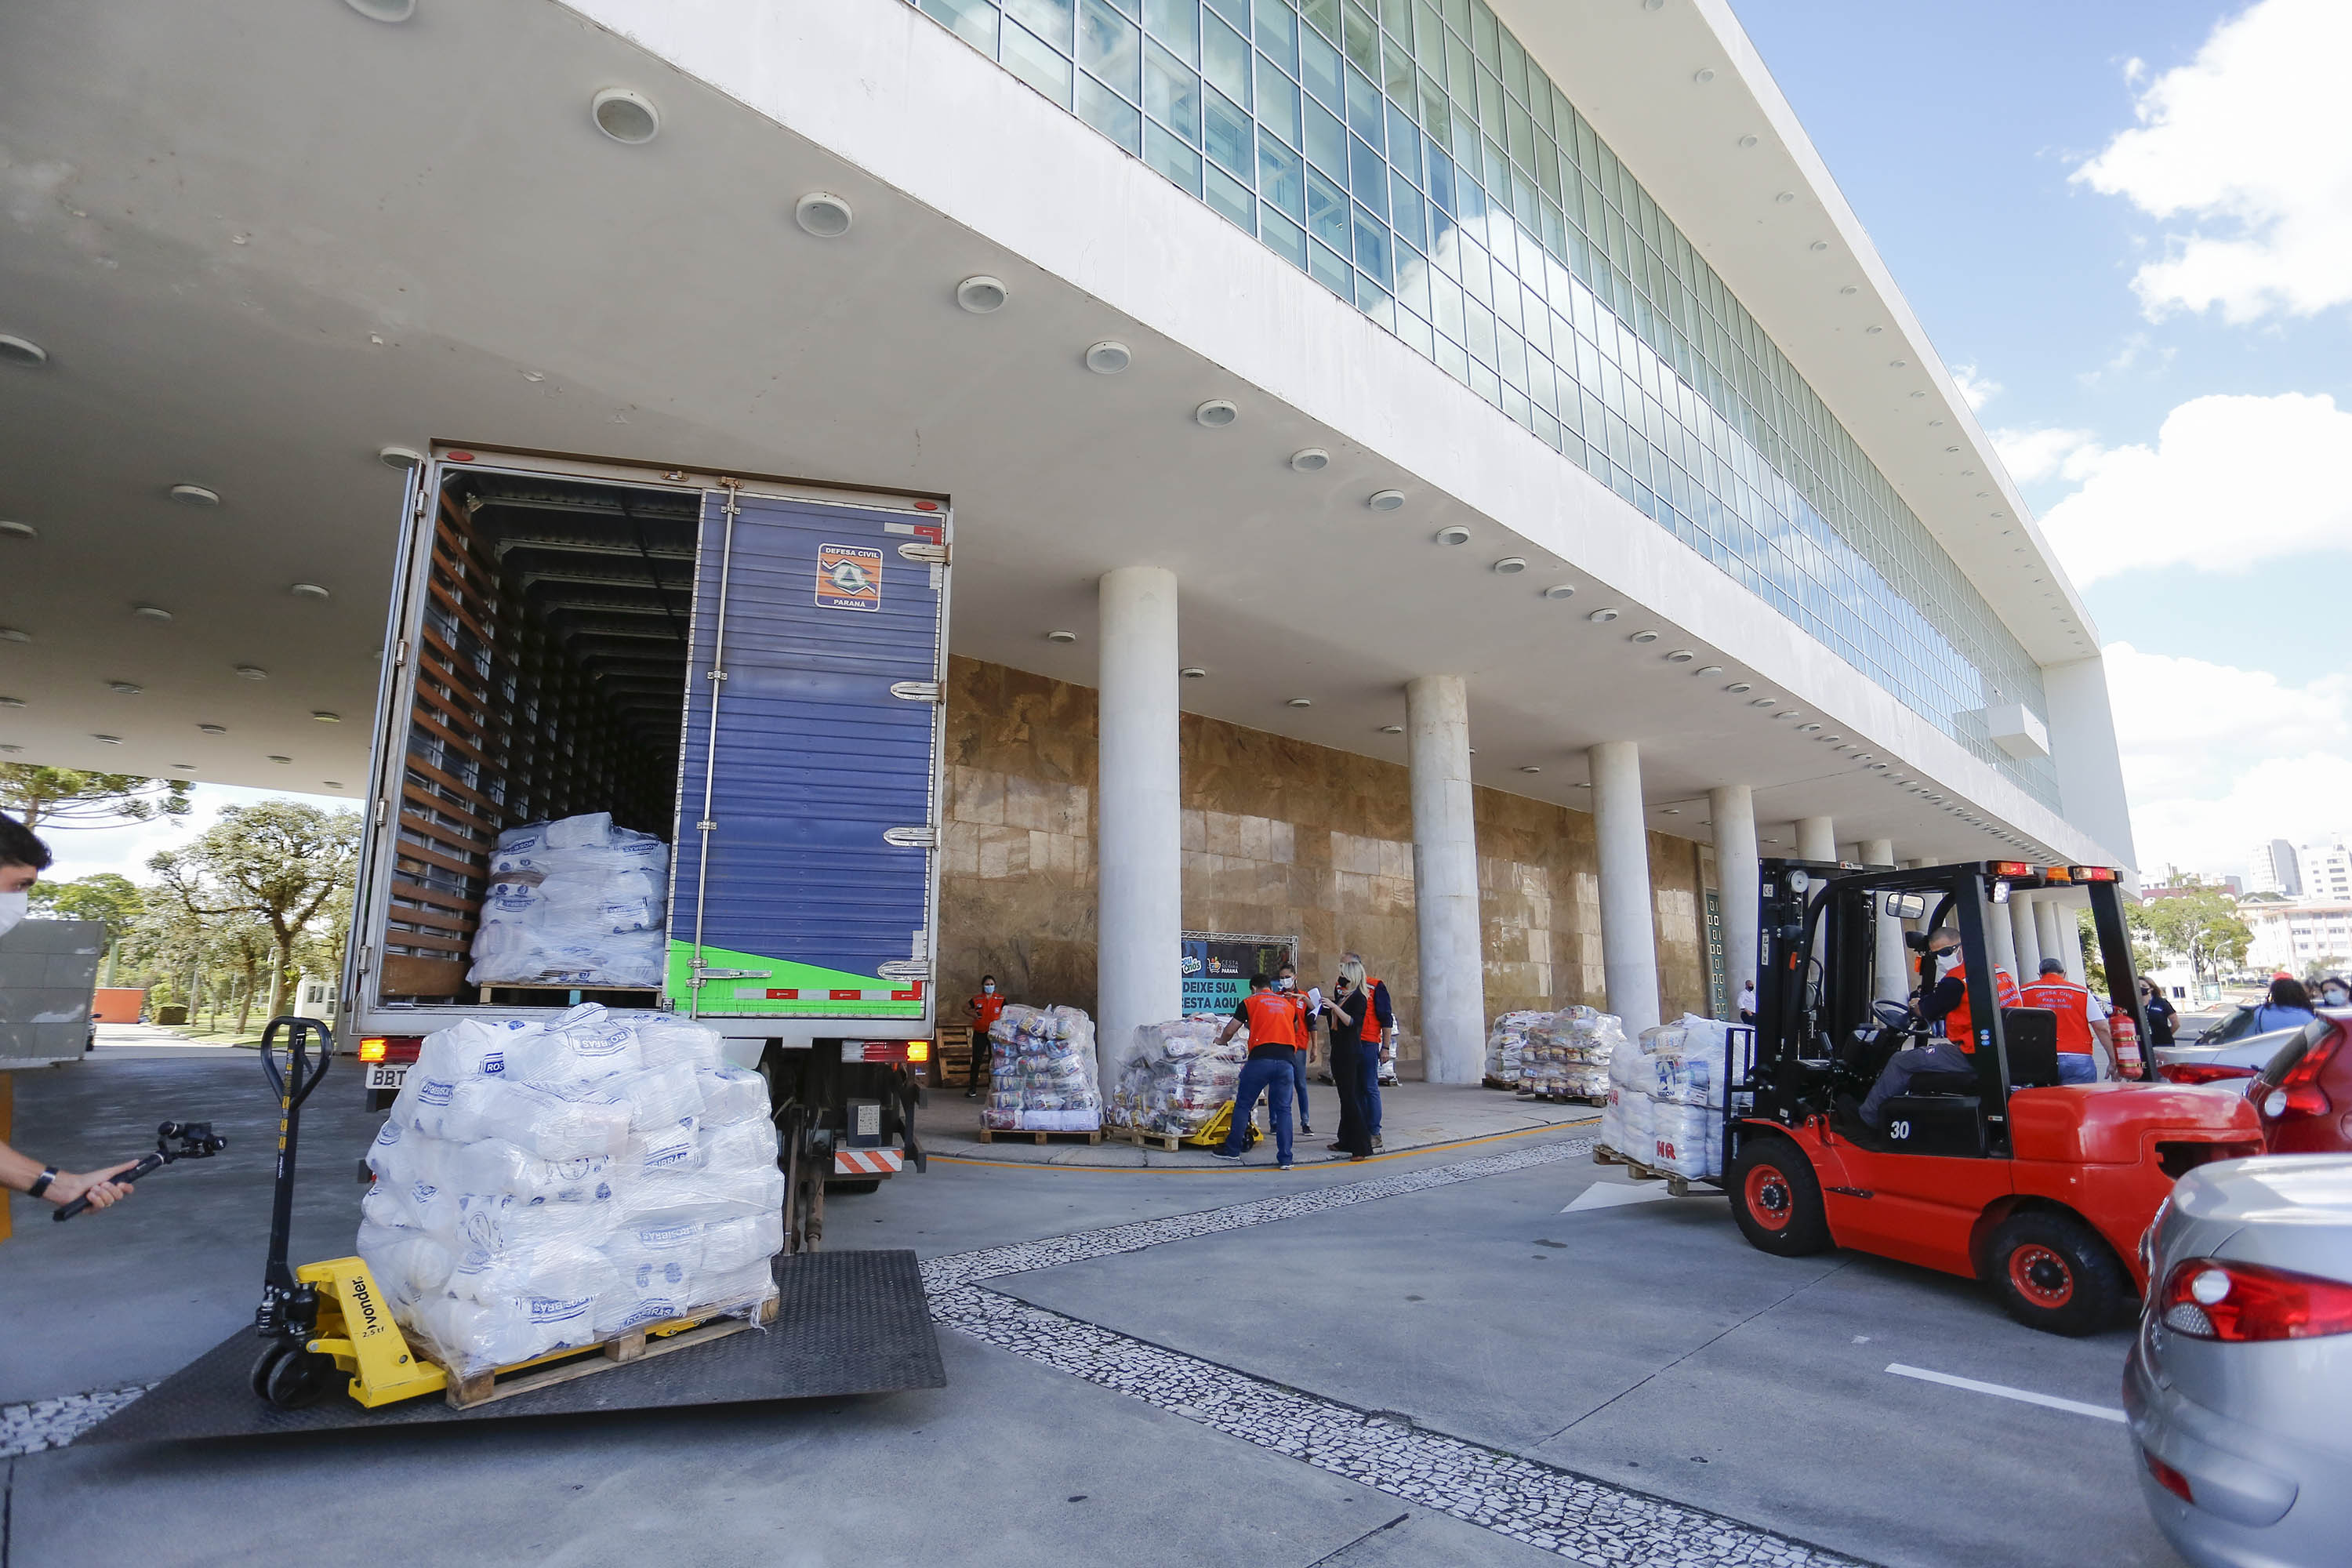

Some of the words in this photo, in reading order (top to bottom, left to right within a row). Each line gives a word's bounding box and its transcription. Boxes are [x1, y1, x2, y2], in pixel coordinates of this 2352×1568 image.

[826, 547, 856, 556] DEFESA
[833, 599, 866, 608] PARANÁ
[1182, 982, 1214, 993] DEIXE
[1215, 982, 1237, 993] SUA
[1181, 996, 1211, 1008] ESTA
[1890, 1120, 1910, 1139] 30
[1656, 1140, 1676, 1160] HR
[351, 1279, 377, 1324] vonder
